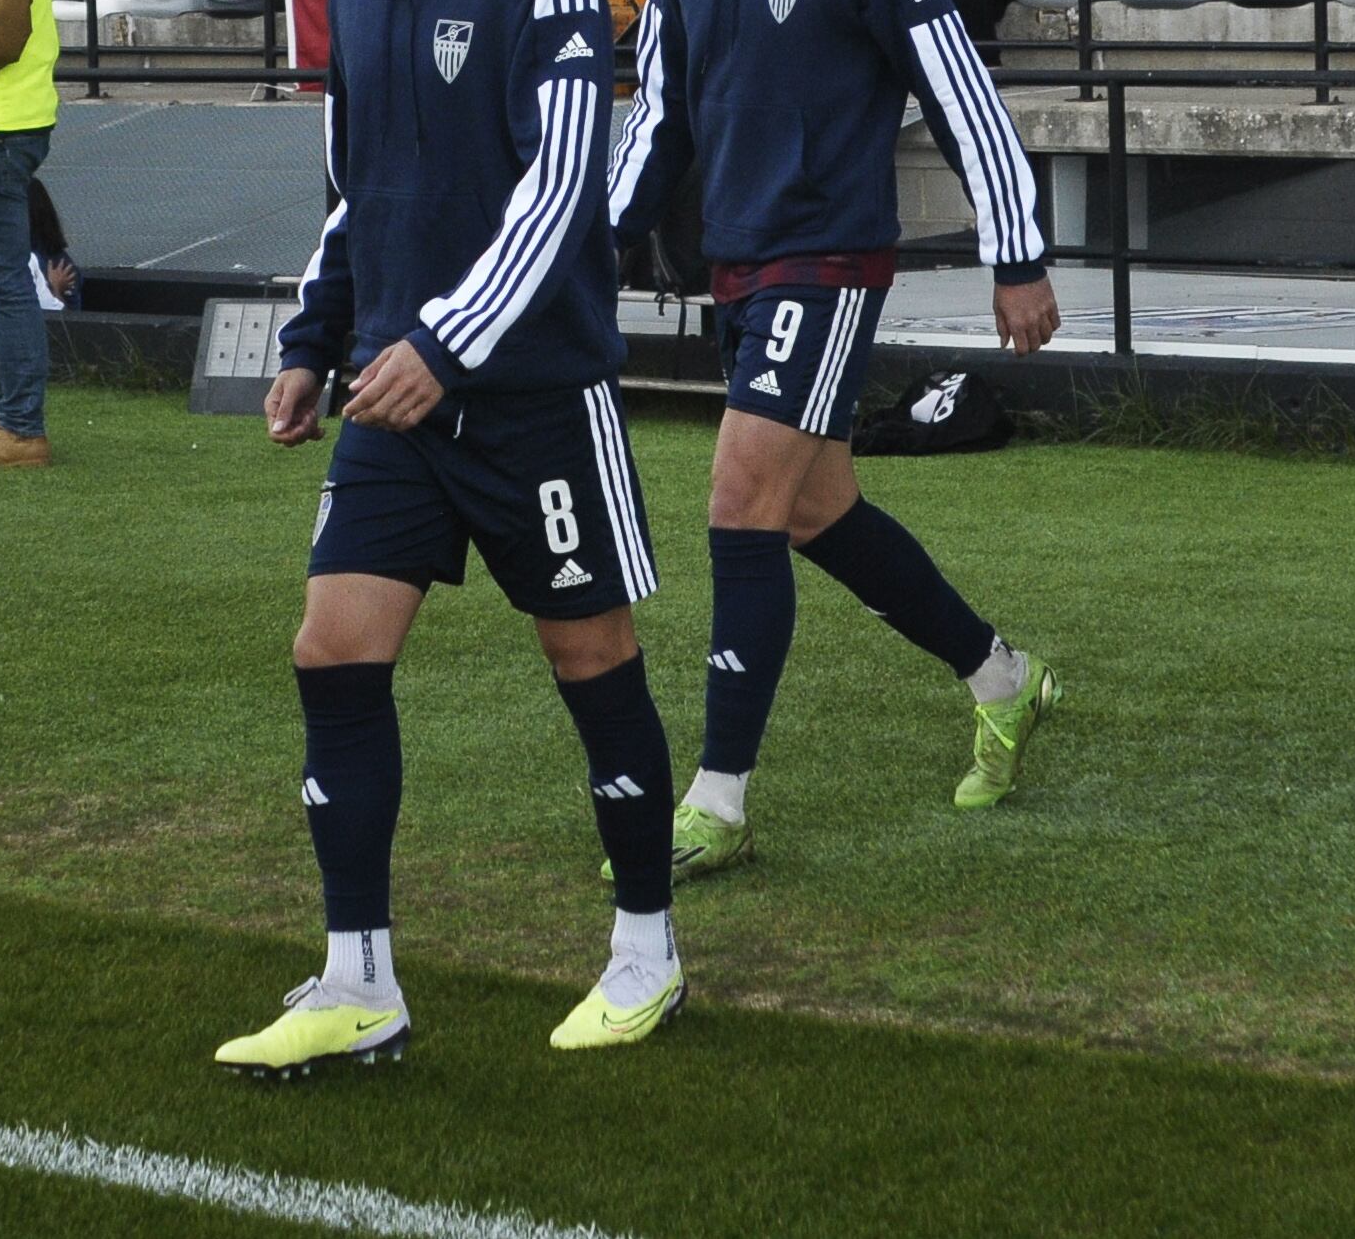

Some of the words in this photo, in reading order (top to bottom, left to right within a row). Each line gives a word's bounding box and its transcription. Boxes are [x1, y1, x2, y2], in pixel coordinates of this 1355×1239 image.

[554, 47, 594, 63] adidas
[766, 300, 804, 363] 9
[749, 380, 782, 397] adidas
[539, 479, 580, 554] 8
[551, 572, 593, 589] adidas
